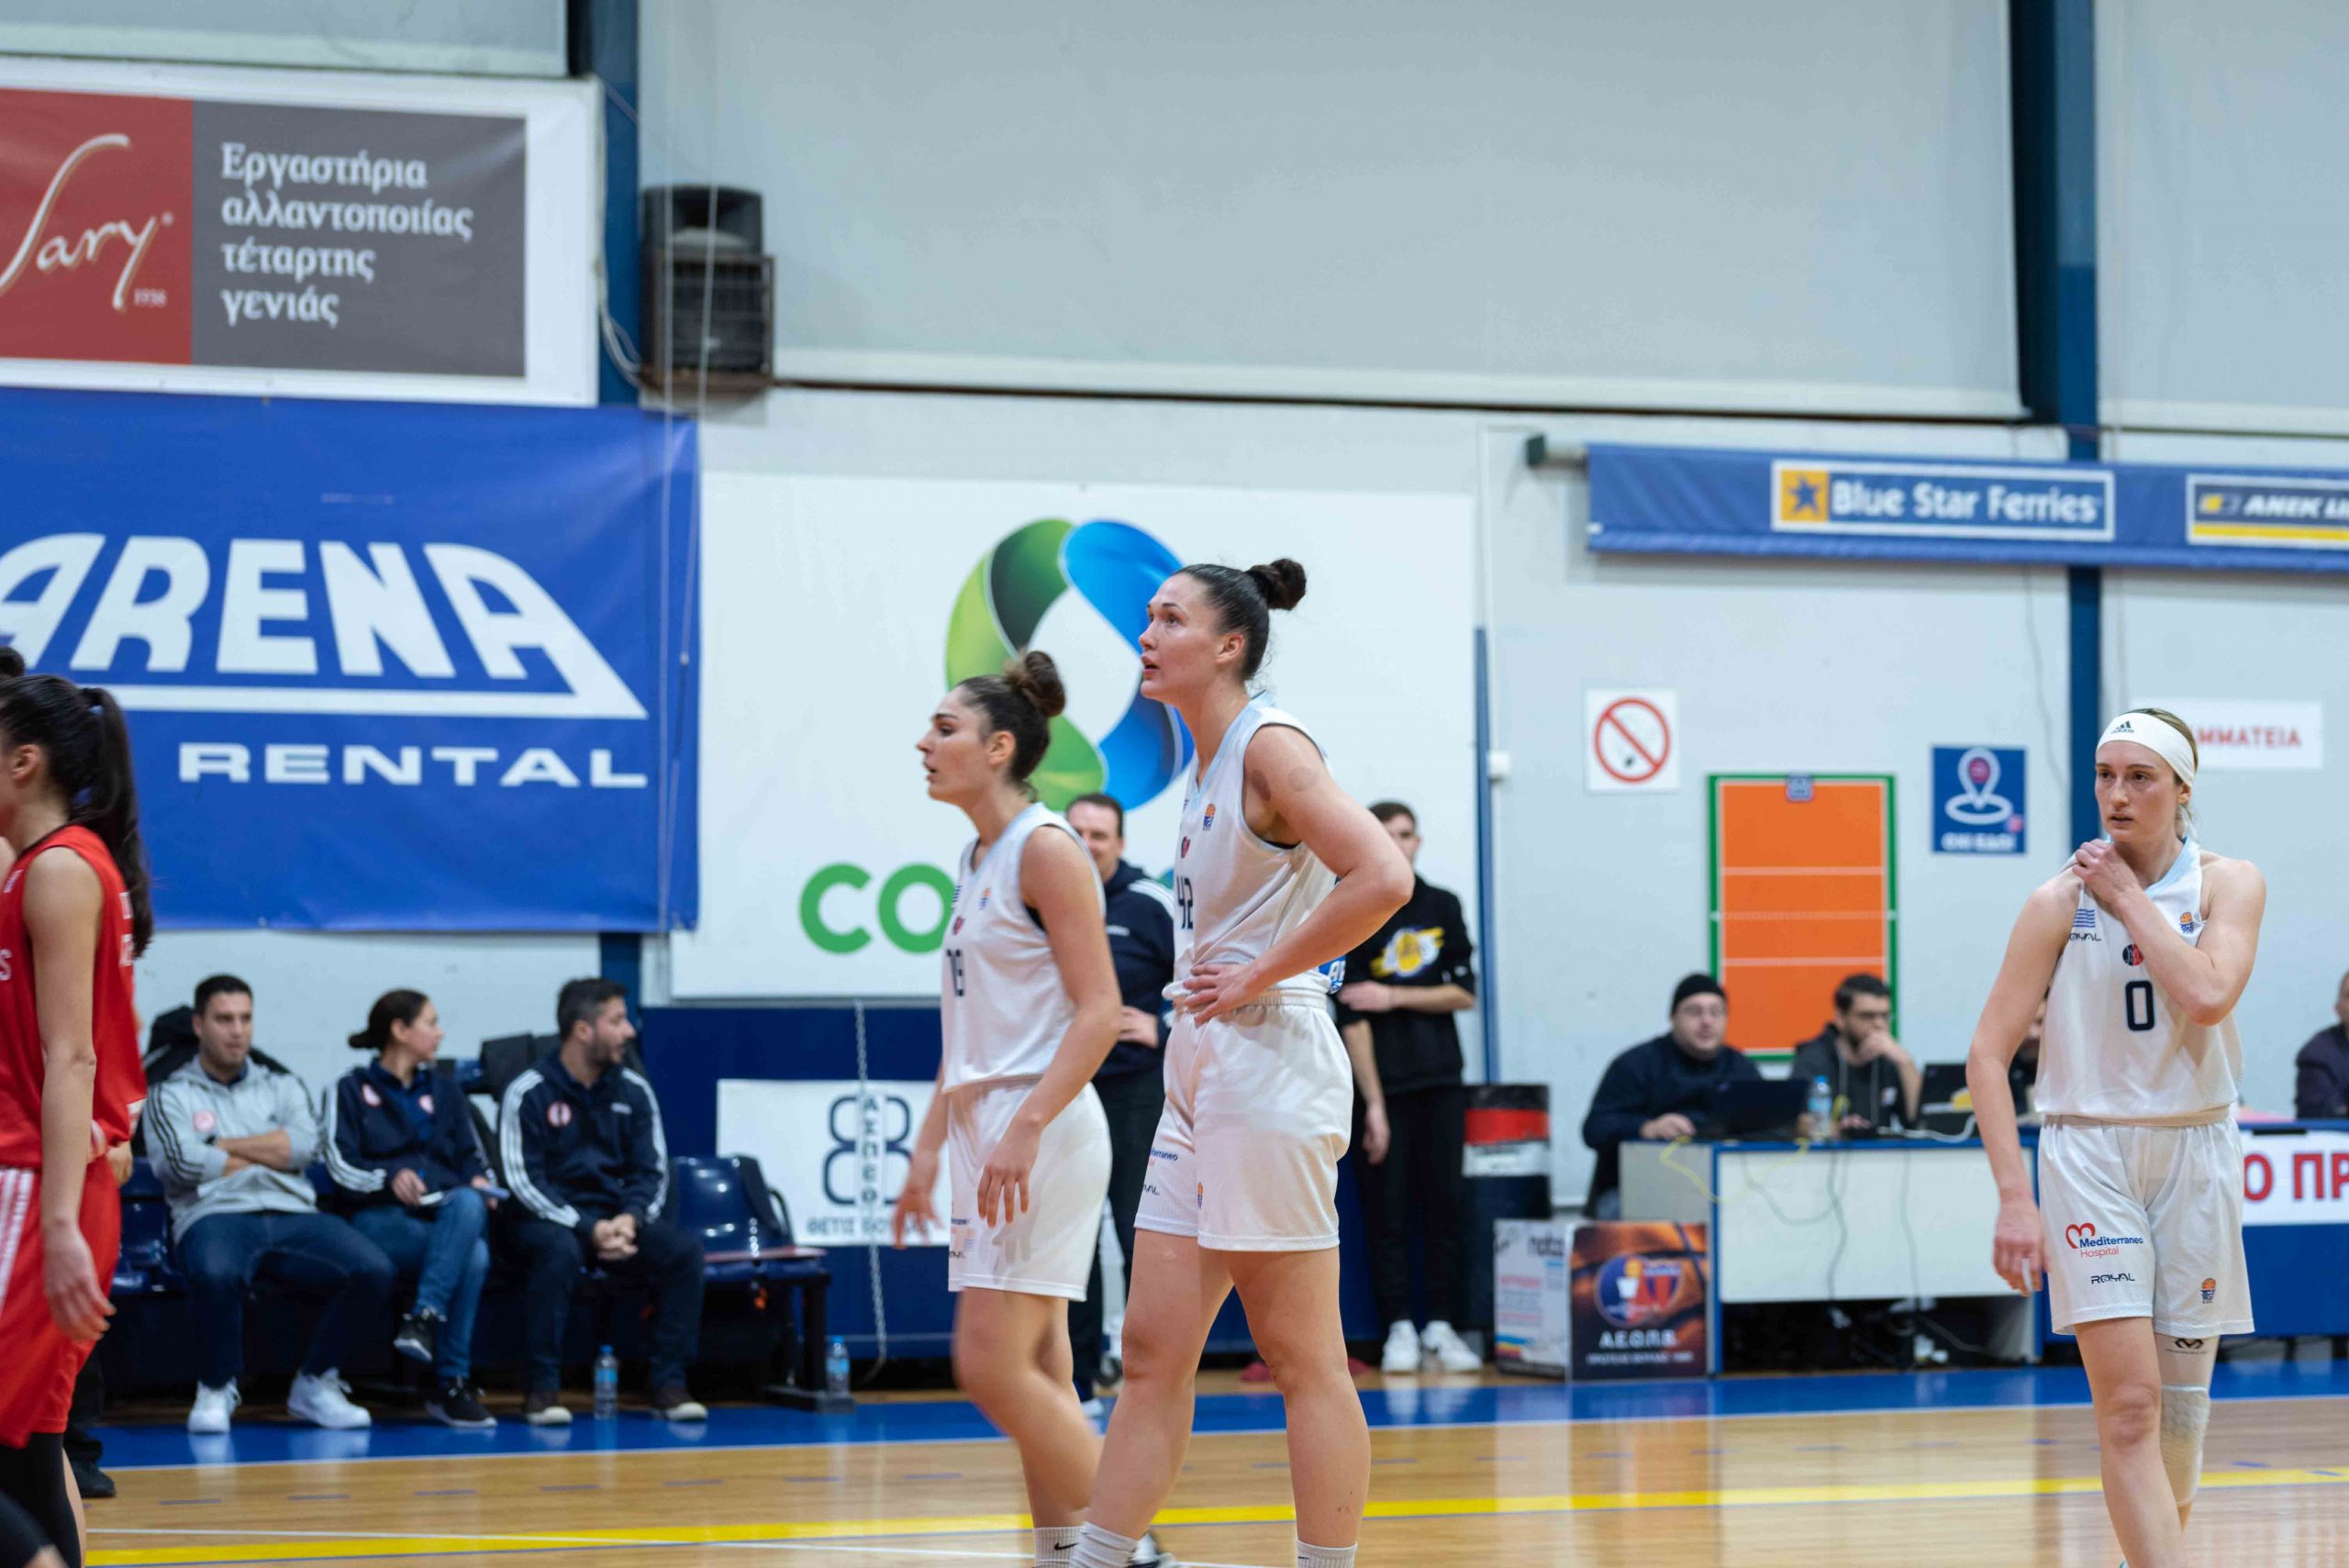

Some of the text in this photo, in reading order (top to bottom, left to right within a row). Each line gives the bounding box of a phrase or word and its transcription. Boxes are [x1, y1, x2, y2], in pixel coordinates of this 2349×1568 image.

[221, 142, 428, 195] Εργαστήρια
[221, 188, 474, 243] αλλαντοποιίας
[221, 236, 377, 284] τέταρτης
[221, 284, 340, 328] γενιάς
[1832, 480, 2098, 524] Blue Star Ferries
[2244, 494, 2322, 518] ANEK
[0, 533, 648, 719] ARENA
[180, 743, 648, 788] RENTAL
[1176, 875, 1194, 929] 42
[2125, 980, 2154, 1031] 0
[2079, 1236, 2143, 1249] Mediterraneo
[2080, 1246, 2119, 1259] Hospital
[2090, 1273, 2135, 1284] ROYAL
